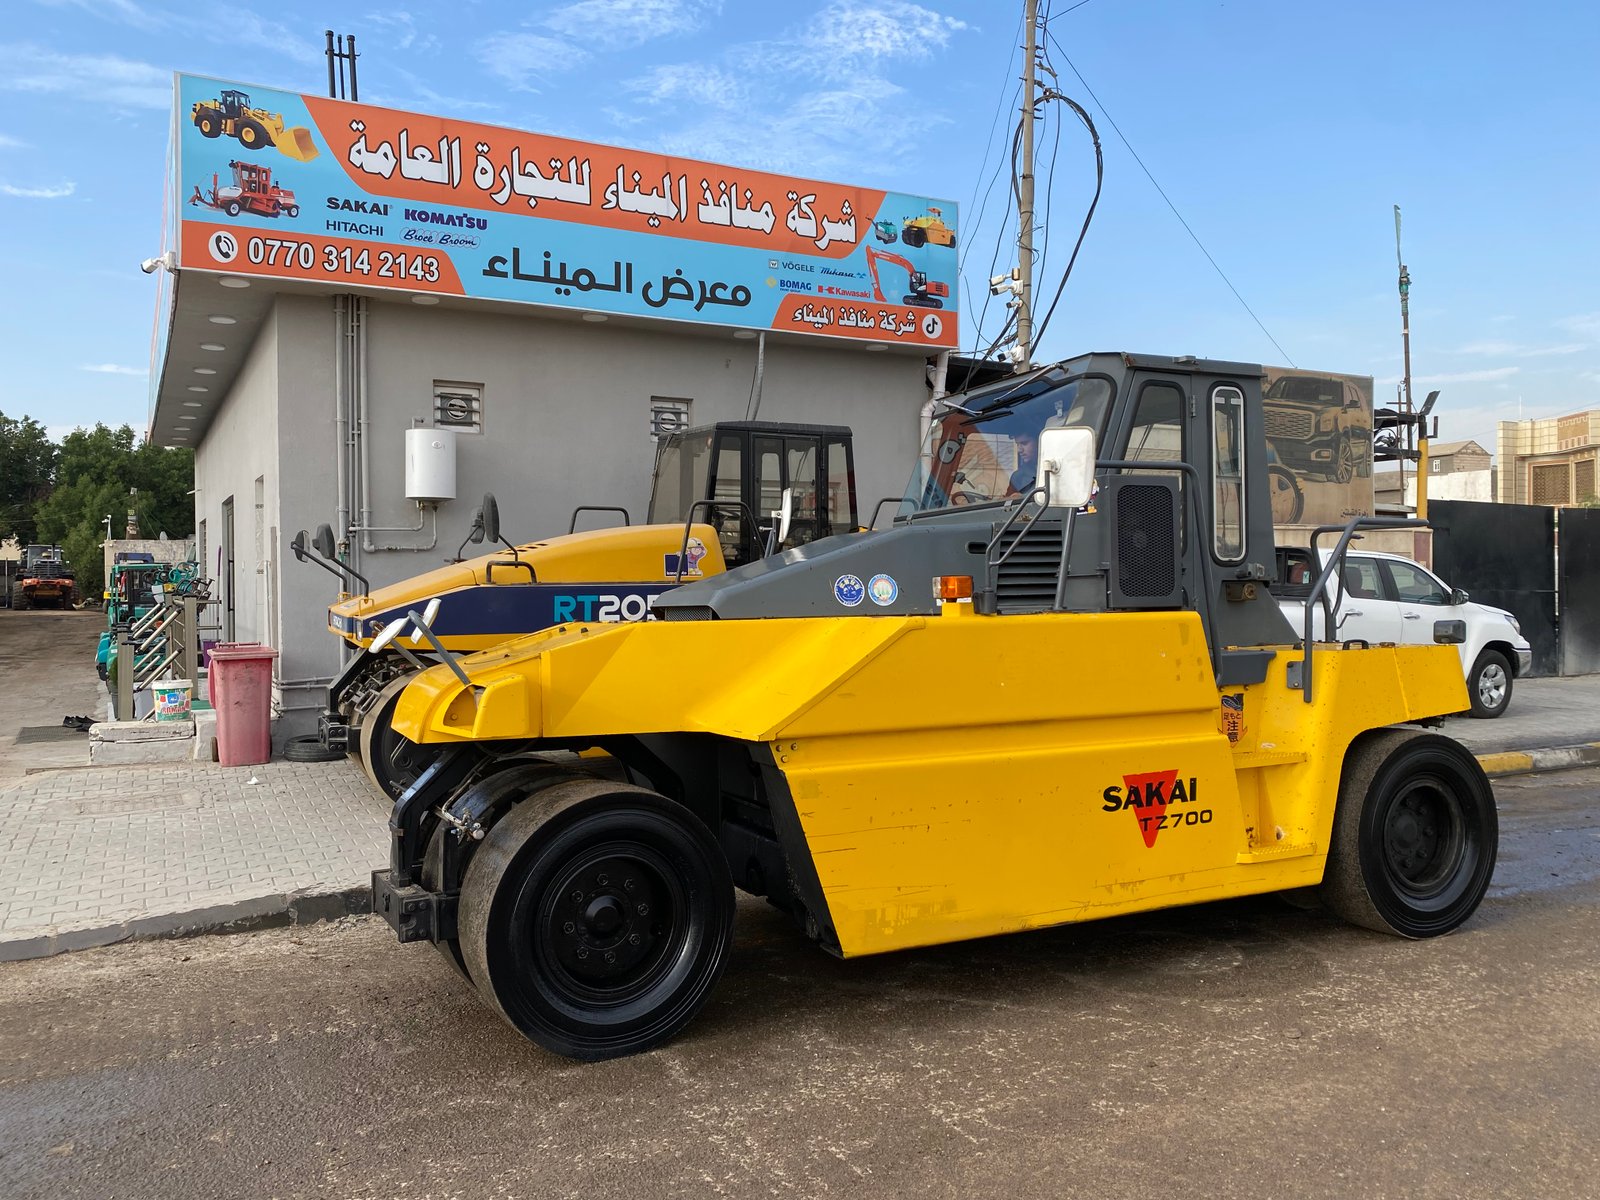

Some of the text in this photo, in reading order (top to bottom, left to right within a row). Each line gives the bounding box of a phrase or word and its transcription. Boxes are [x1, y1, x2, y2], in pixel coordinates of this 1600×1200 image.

[348, 119, 857, 251] شركة منافذ الميناء للتجارة العامة
[326, 197, 389, 216] SAKAI
[326, 220, 384, 236] HITACHI
[404, 208, 488, 231] KOMATSU
[438, 234, 478, 246] Broom
[247, 236, 440, 283] 0770 314 2143
[780, 261, 815, 273] VÖGELE
[482, 247, 752, 313] معرض الميناء
[779, 279, 812, 291] BOMAG
[835, 287, 871, 299] Kawasaki
[792, 302, 916, 336] شركة منافذ الميناء
[1101, 777, 1198, 813] SAKAI
[1139, 809, 1213, 833] TZ700
